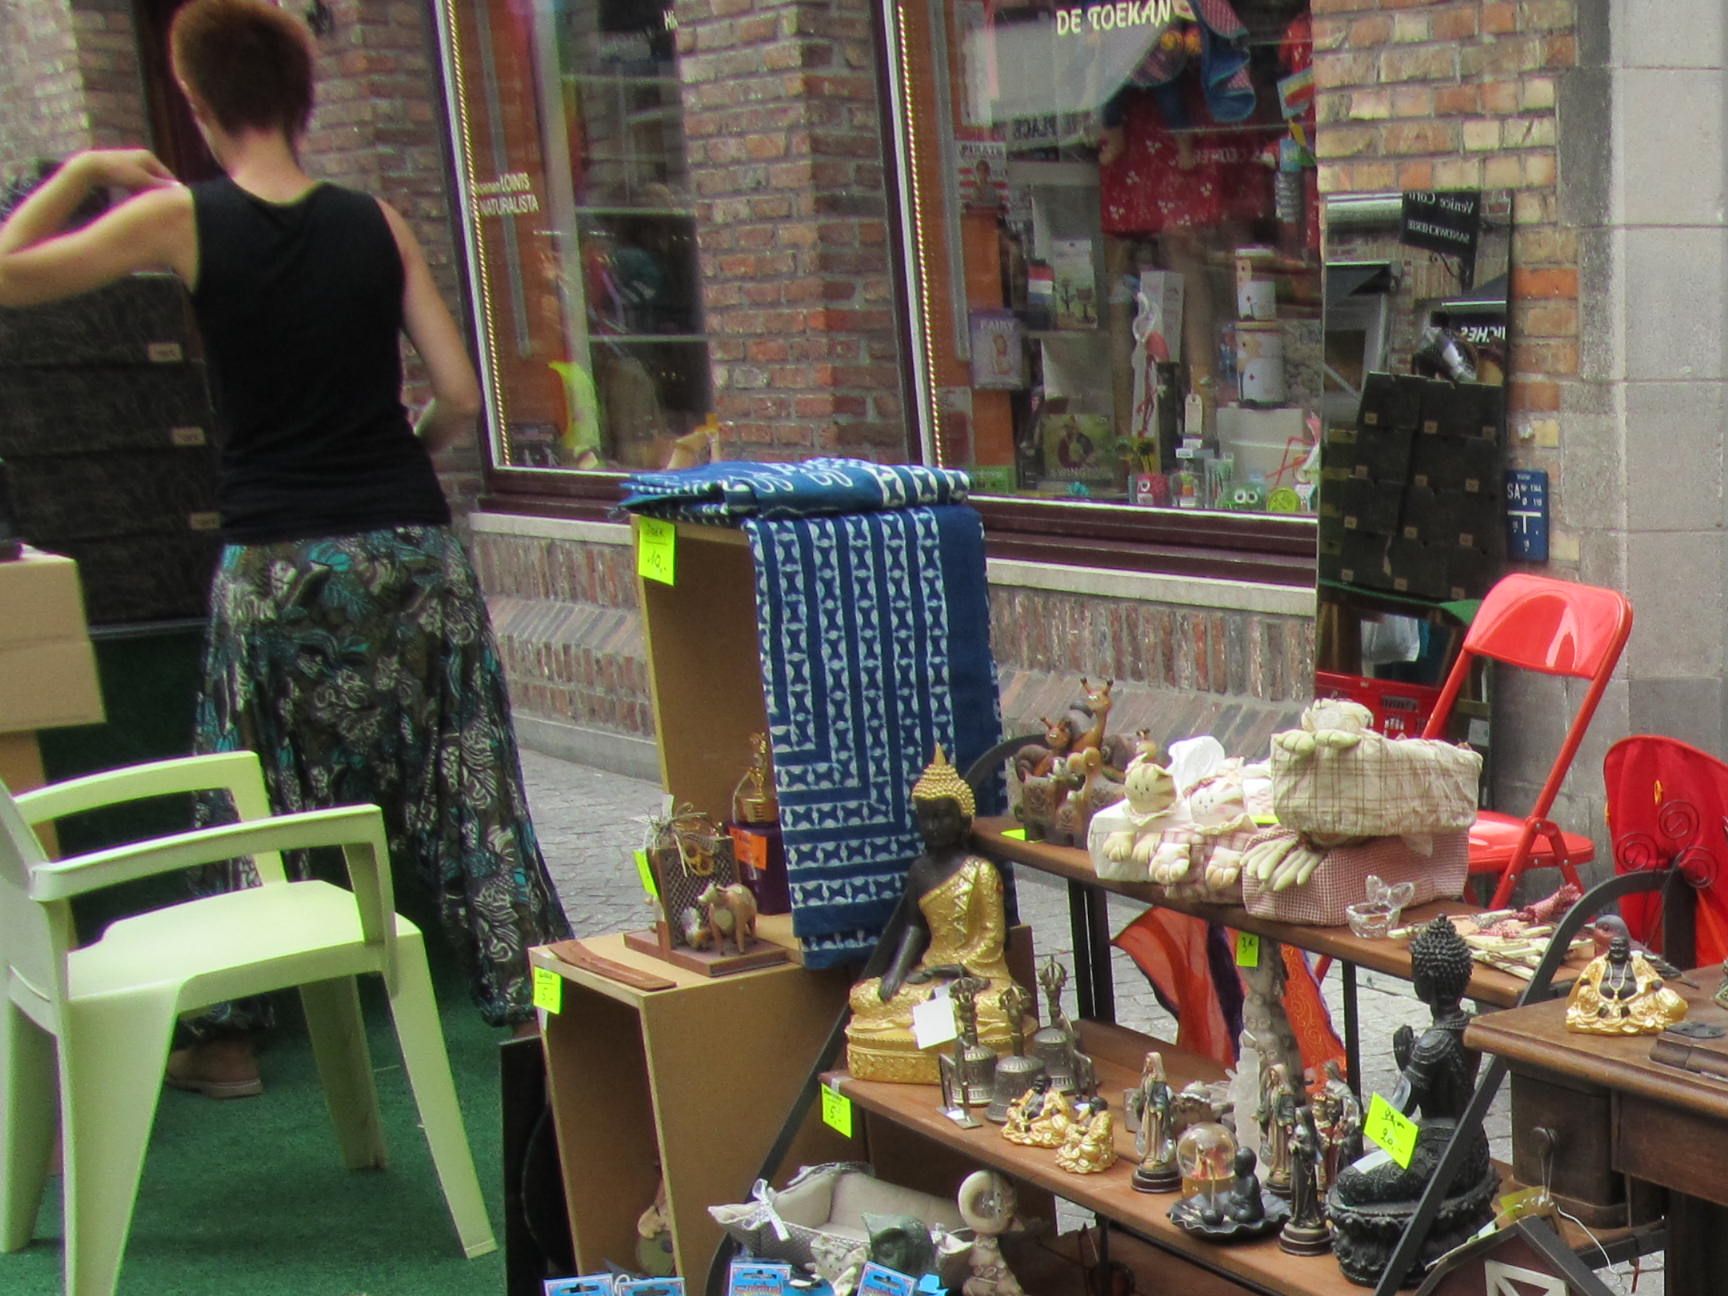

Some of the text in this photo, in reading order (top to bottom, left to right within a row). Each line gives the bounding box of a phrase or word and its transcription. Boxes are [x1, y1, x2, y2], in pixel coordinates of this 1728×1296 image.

[1055, 0, 1171, 36] DE TOEKAN
[479, 194, 540, 217] NATURALISTA
